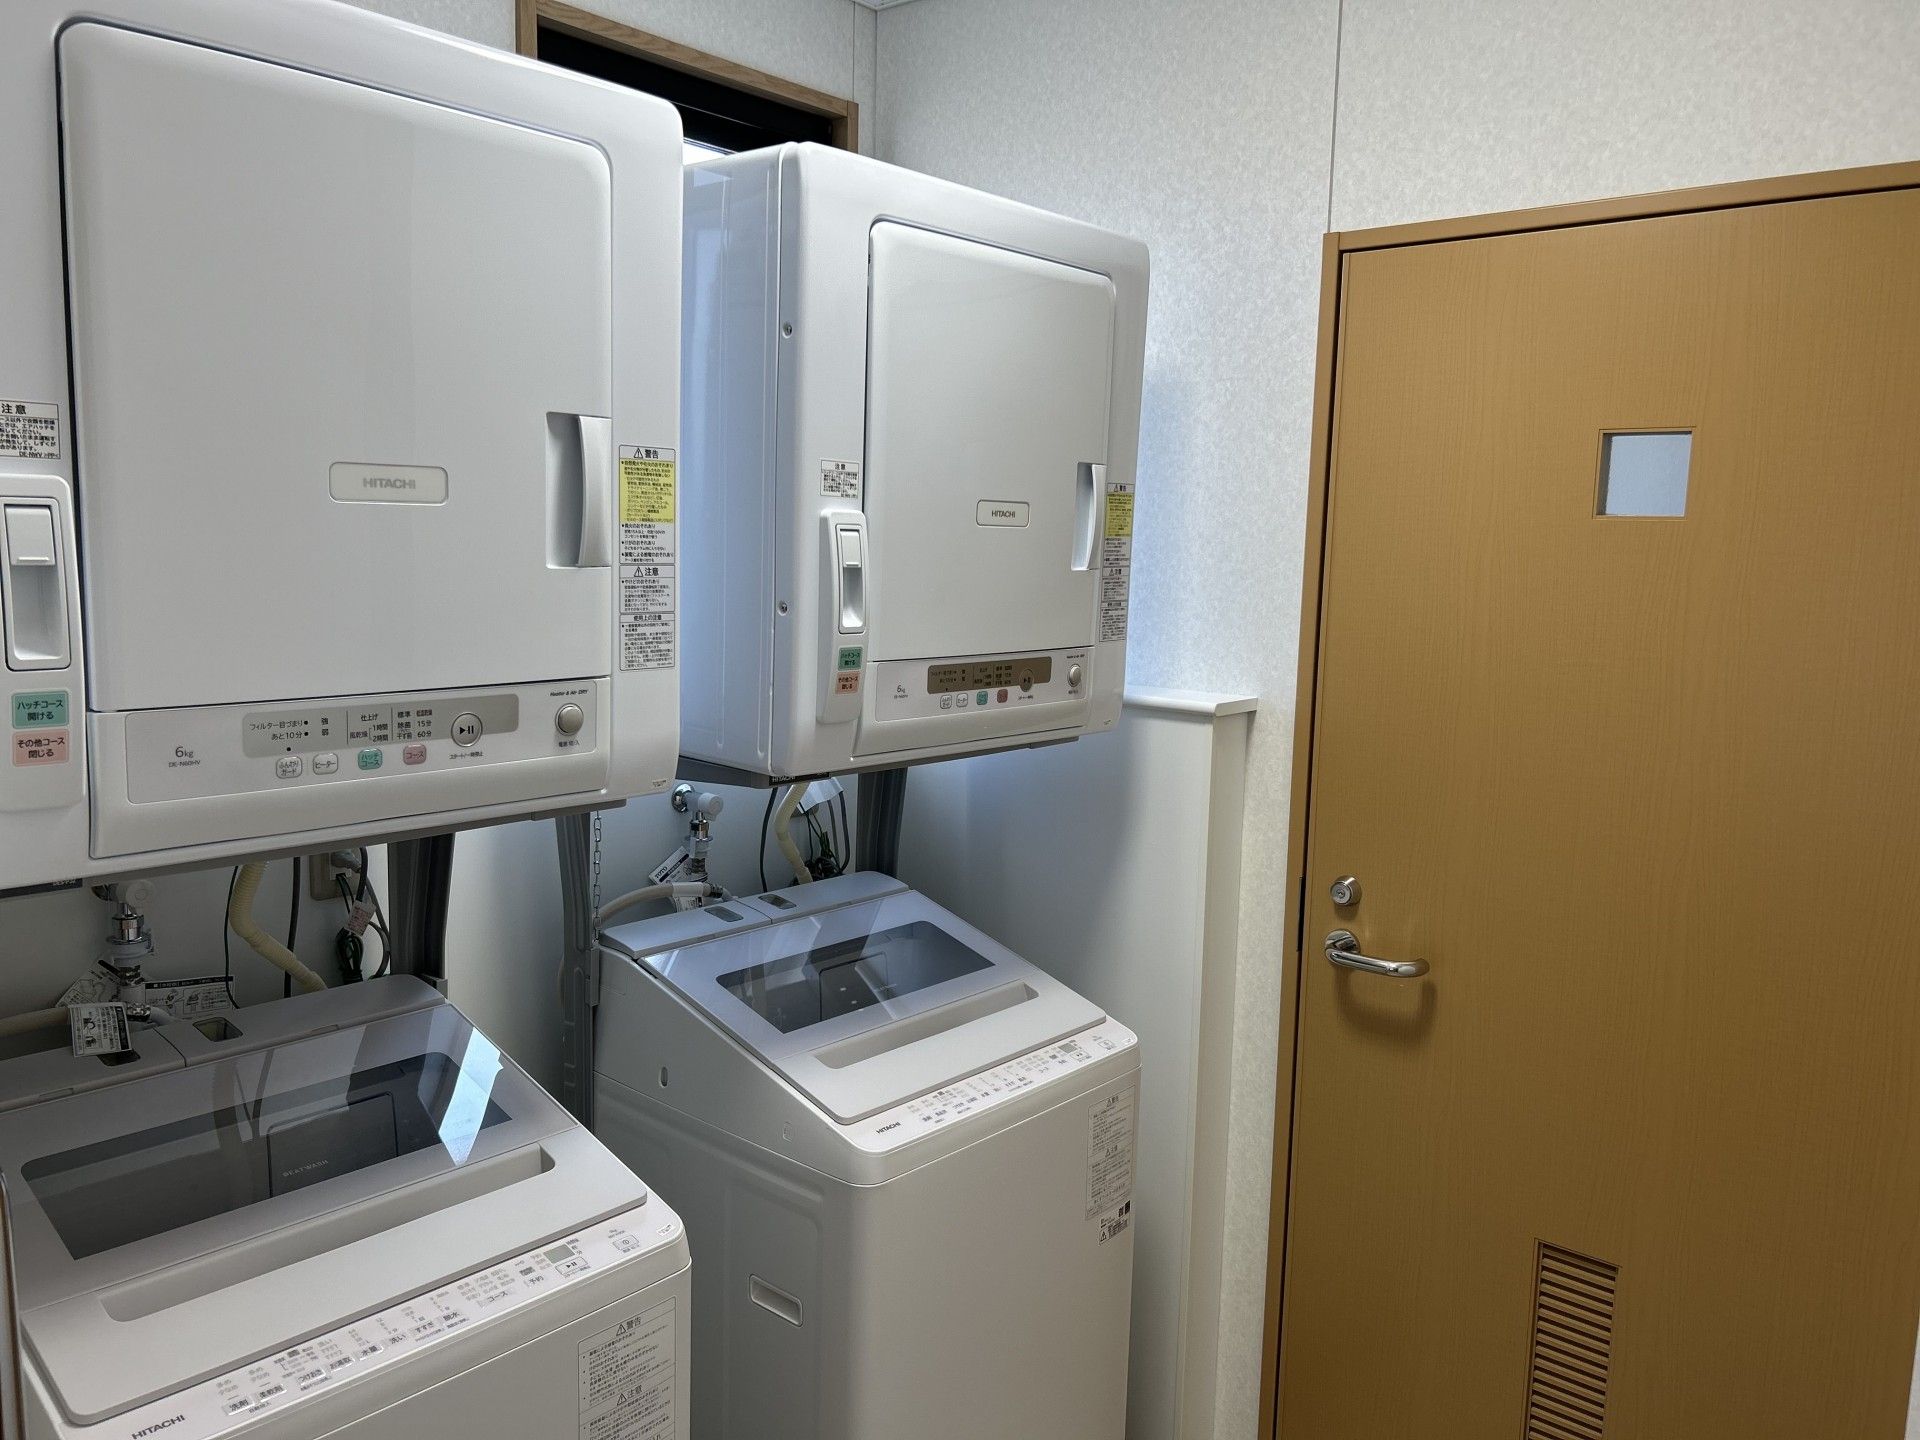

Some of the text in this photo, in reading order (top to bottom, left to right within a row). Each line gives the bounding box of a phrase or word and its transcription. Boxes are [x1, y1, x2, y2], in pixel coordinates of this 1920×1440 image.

[2, 403, 26, 415] 注意
[363, 478, 416, 489] HITACHI
[991, 510, 1016, 519] HITACHI
[645, 567, 659, 576] 注意
[17, 700, 63, 709] ハッチコース
[27, 711, 54, 721] 開ける
[250, 720, 303, 730] フィルター目づまり
[417, 720, 432, 728] 15分
[271, 730, 302, 740] あと10分
[18, 737, 65, 748] その他コース
[28, 749, 54, 759] 閉じる
[175, 746, 194, 758] 6kg
[361, 753, 379, 761] ハッチ
[406, 751, 425, 759] コース
[314, 761, 336, 769] ヒーター
[876, 1121, 901, 1134] HITACHI
[488, 1290, 509, 1302] コース
[415, 1321, 434, 1333] すすぎ
[391, 1333, 407, 1345] 洗い
[361, 1345, 378, 1357] 水量
[298, 1368, 322, 1383] つけおき
[228, 1398, 249, 1413] 洗剤
[131, 1414, 185, 1439] HITACHI
